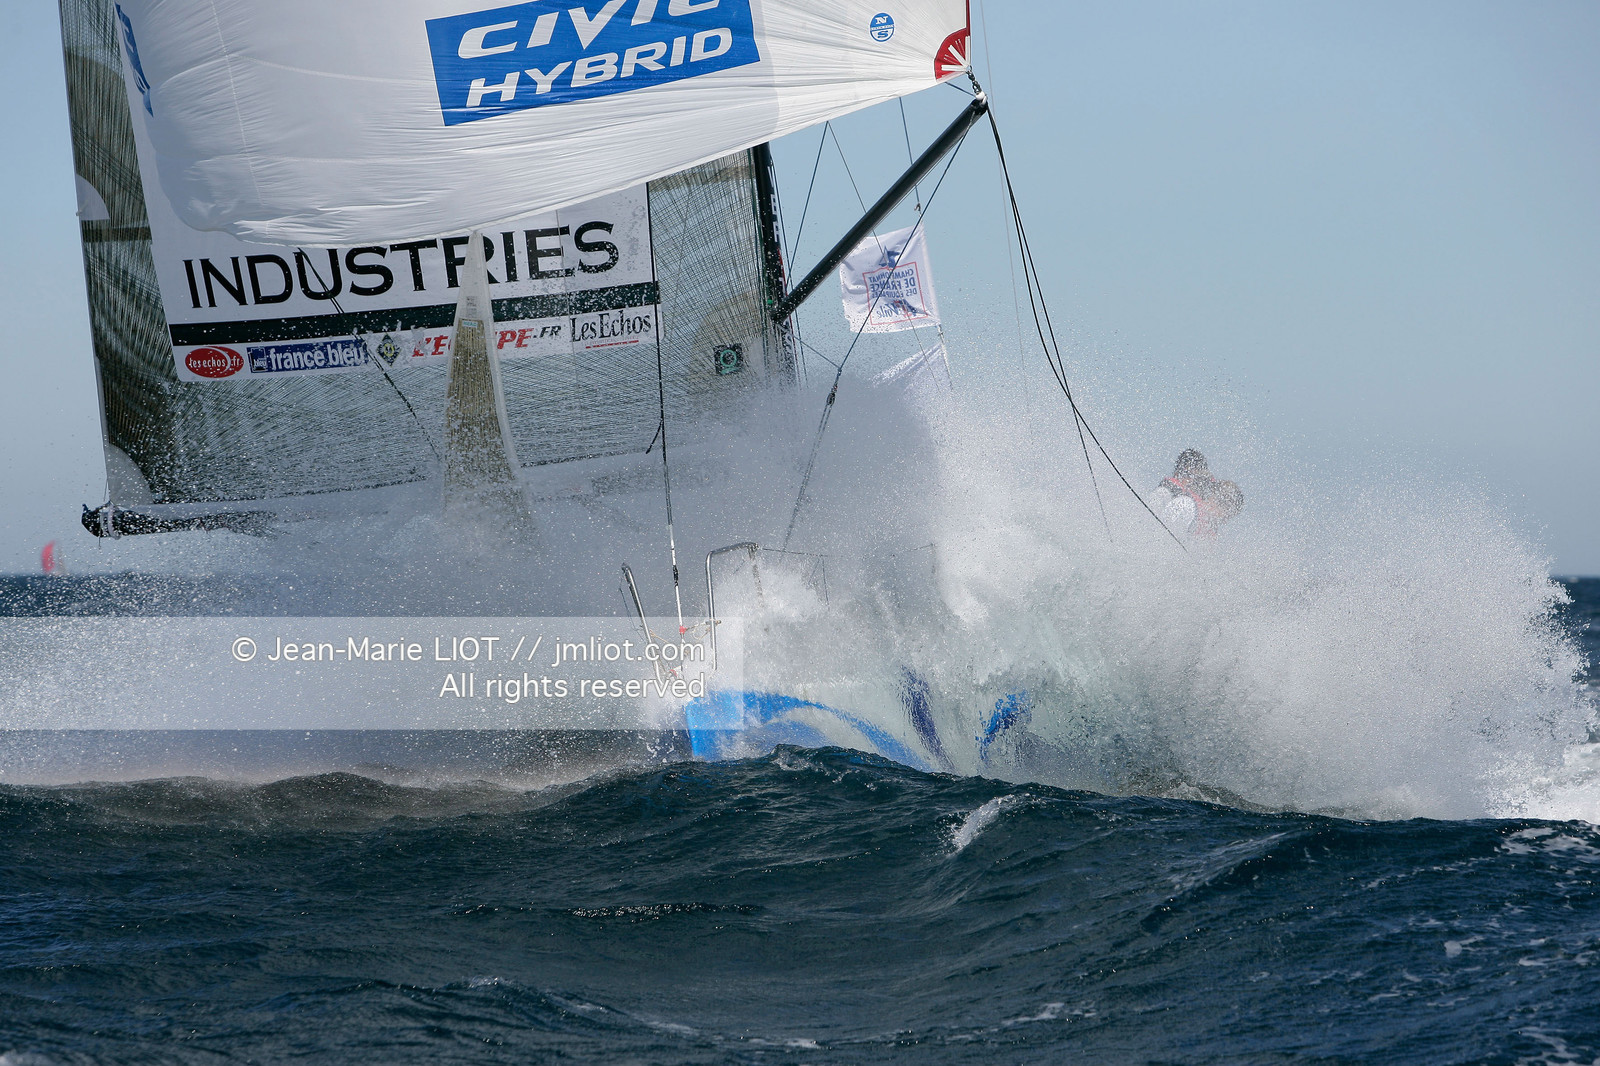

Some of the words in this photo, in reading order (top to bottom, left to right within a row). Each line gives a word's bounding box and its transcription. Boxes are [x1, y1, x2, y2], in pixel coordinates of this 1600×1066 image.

[465, 27, 733, 108] HYBRID
[182, 221, 620, 309] INDUSTRIES
[270, 347, 326, 371] france
